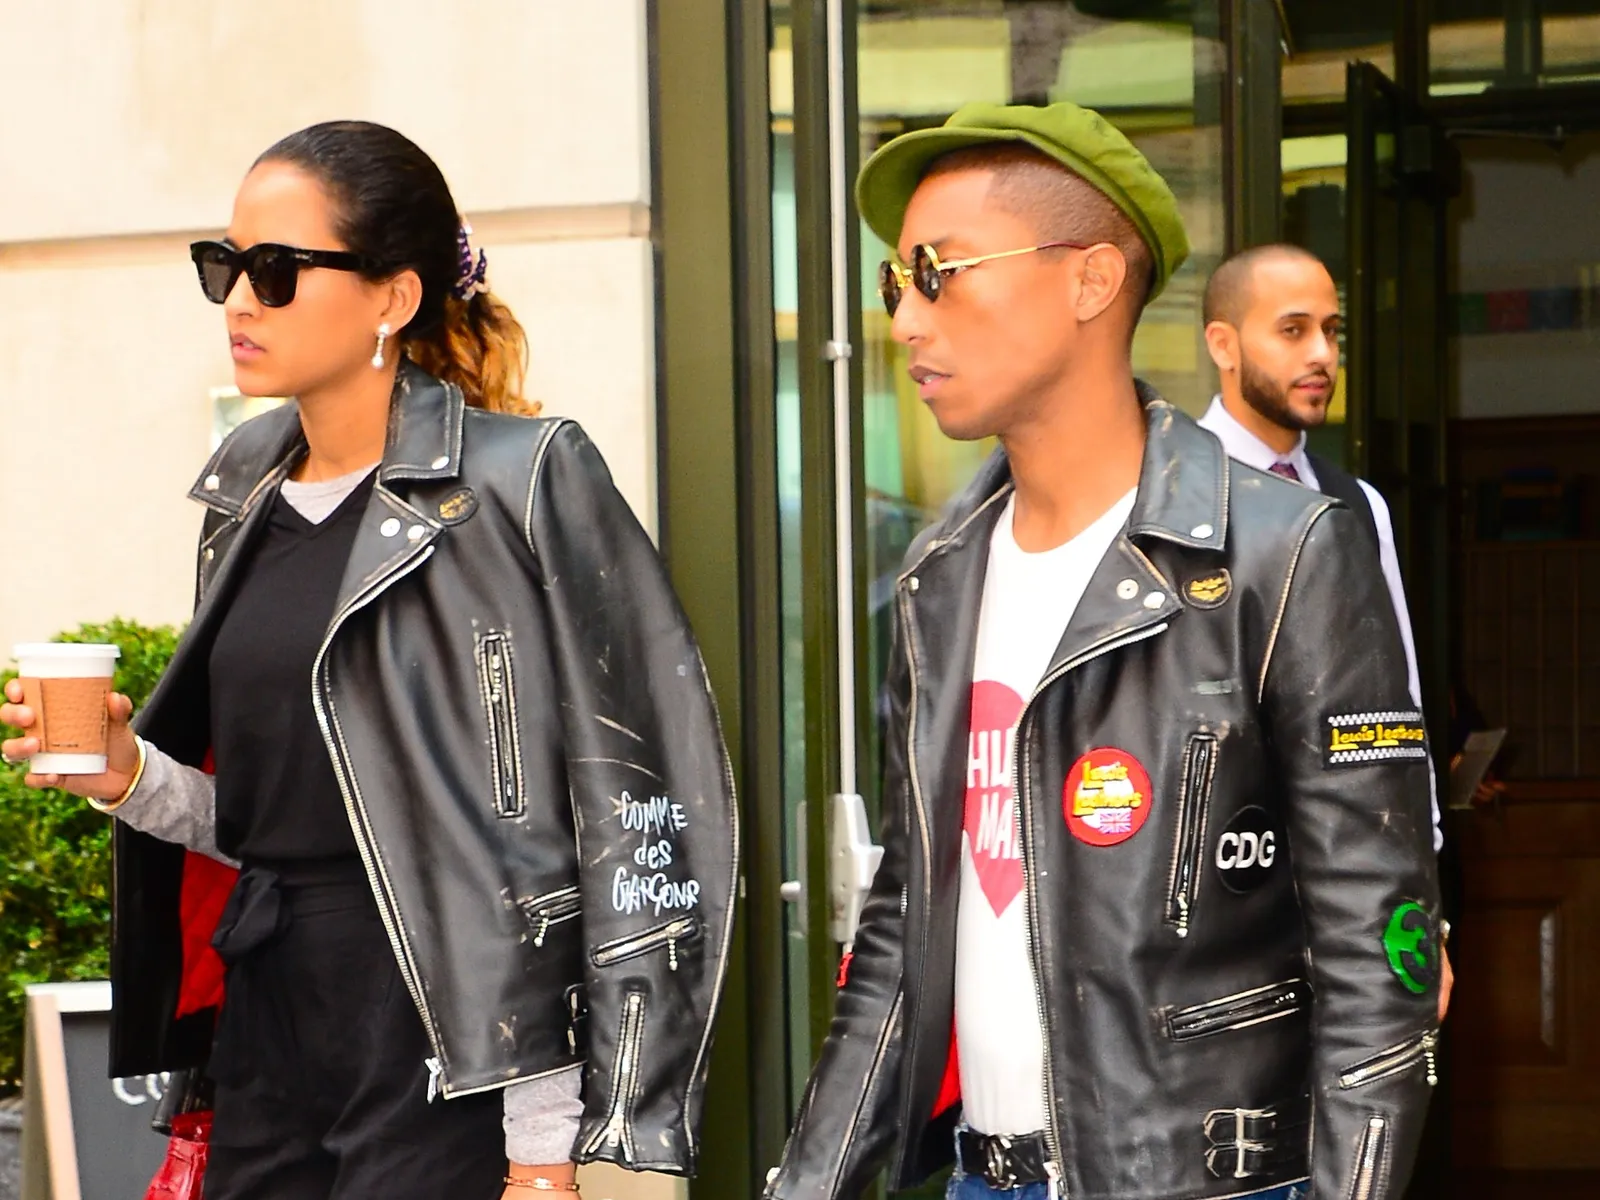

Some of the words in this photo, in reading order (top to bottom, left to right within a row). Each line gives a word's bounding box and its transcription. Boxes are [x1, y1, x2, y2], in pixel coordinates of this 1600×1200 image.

[1329, 725, 1375, 751] Lewis
[620, 790, 689, 839] COMME
[634, 834, 672, 870] des
[1215, 830, 1276, 870] CDG
